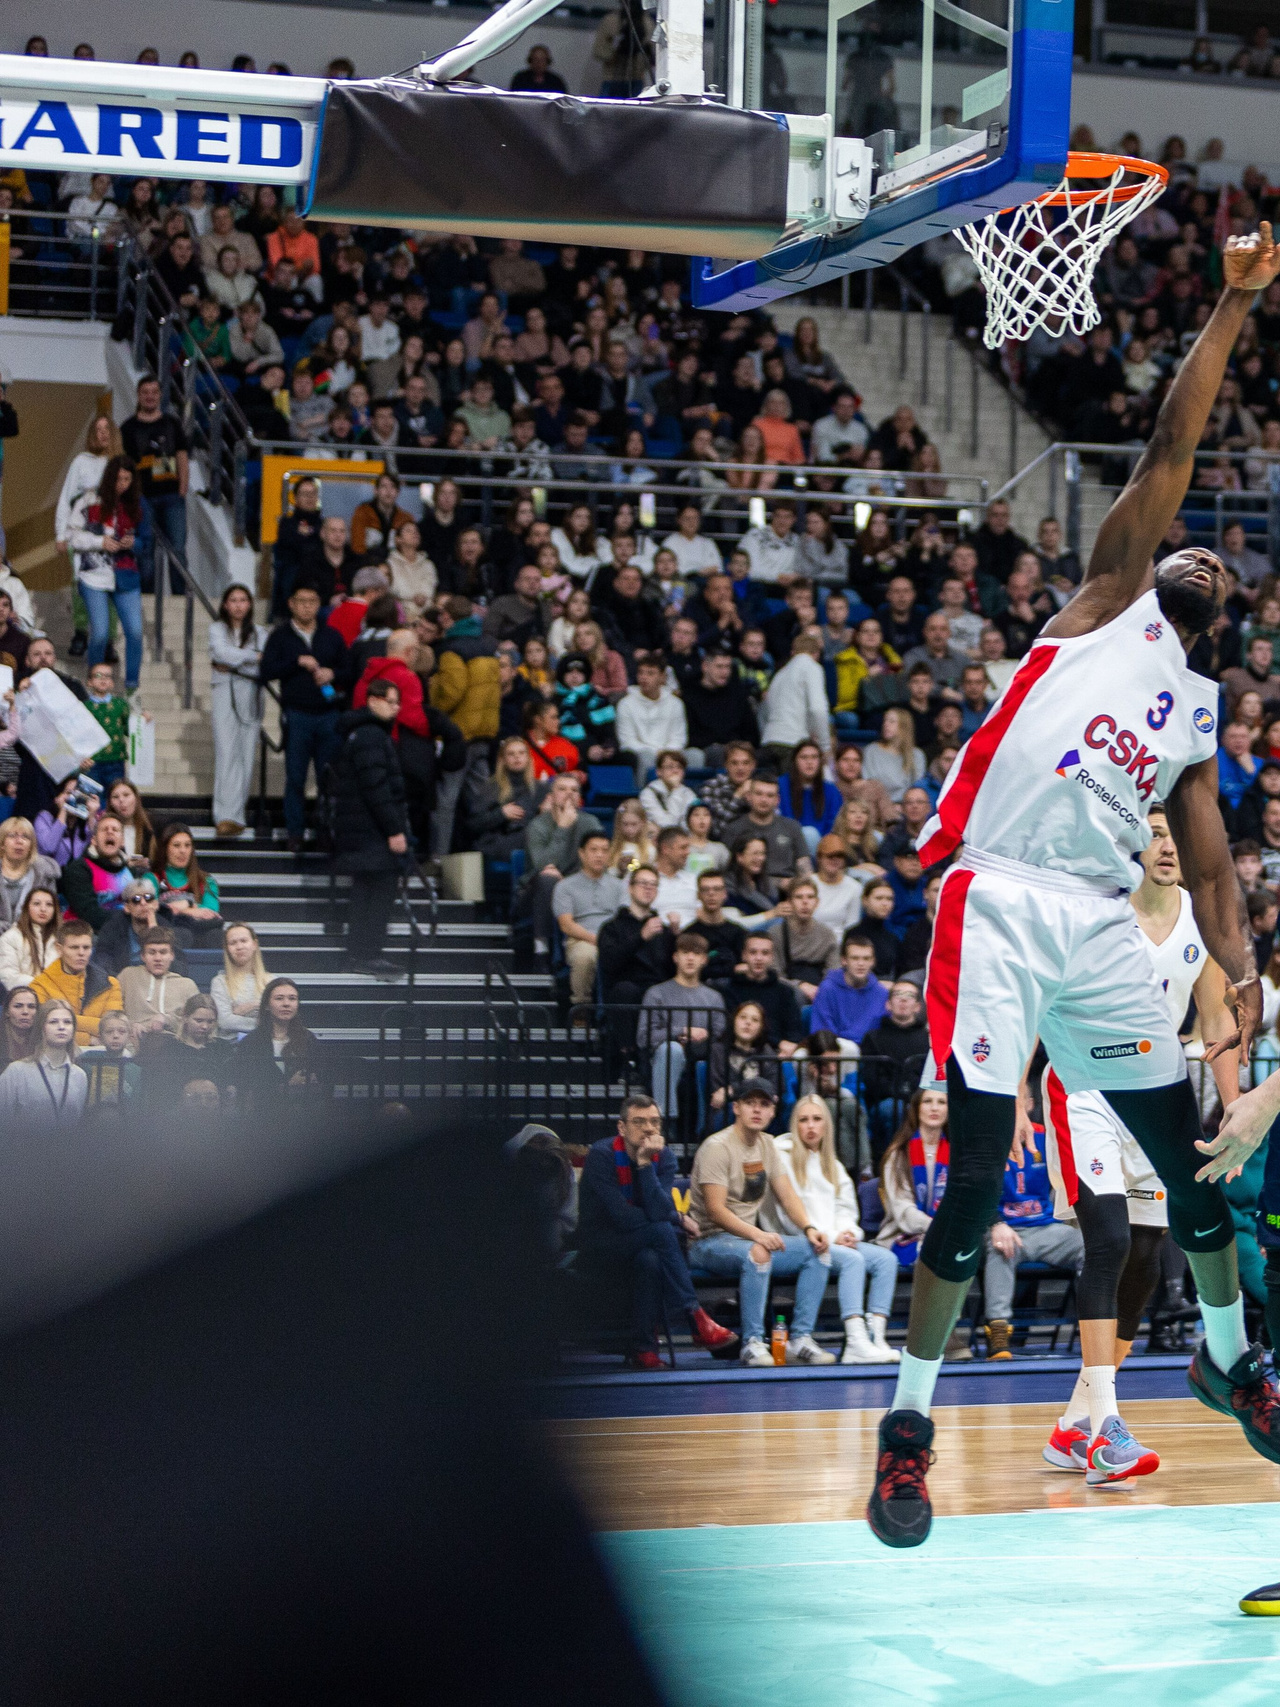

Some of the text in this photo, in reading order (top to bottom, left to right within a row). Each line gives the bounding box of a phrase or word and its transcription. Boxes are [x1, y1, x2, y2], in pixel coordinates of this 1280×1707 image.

[0, 100, 302, 168] ARED
[1147, 690, 1175, 731] 3
[1084, 714, 1160, 802] CSKA
[1075, 768, 1141, 831] Rostelecom
[1093, 1046, 1136, 1057] Winline
